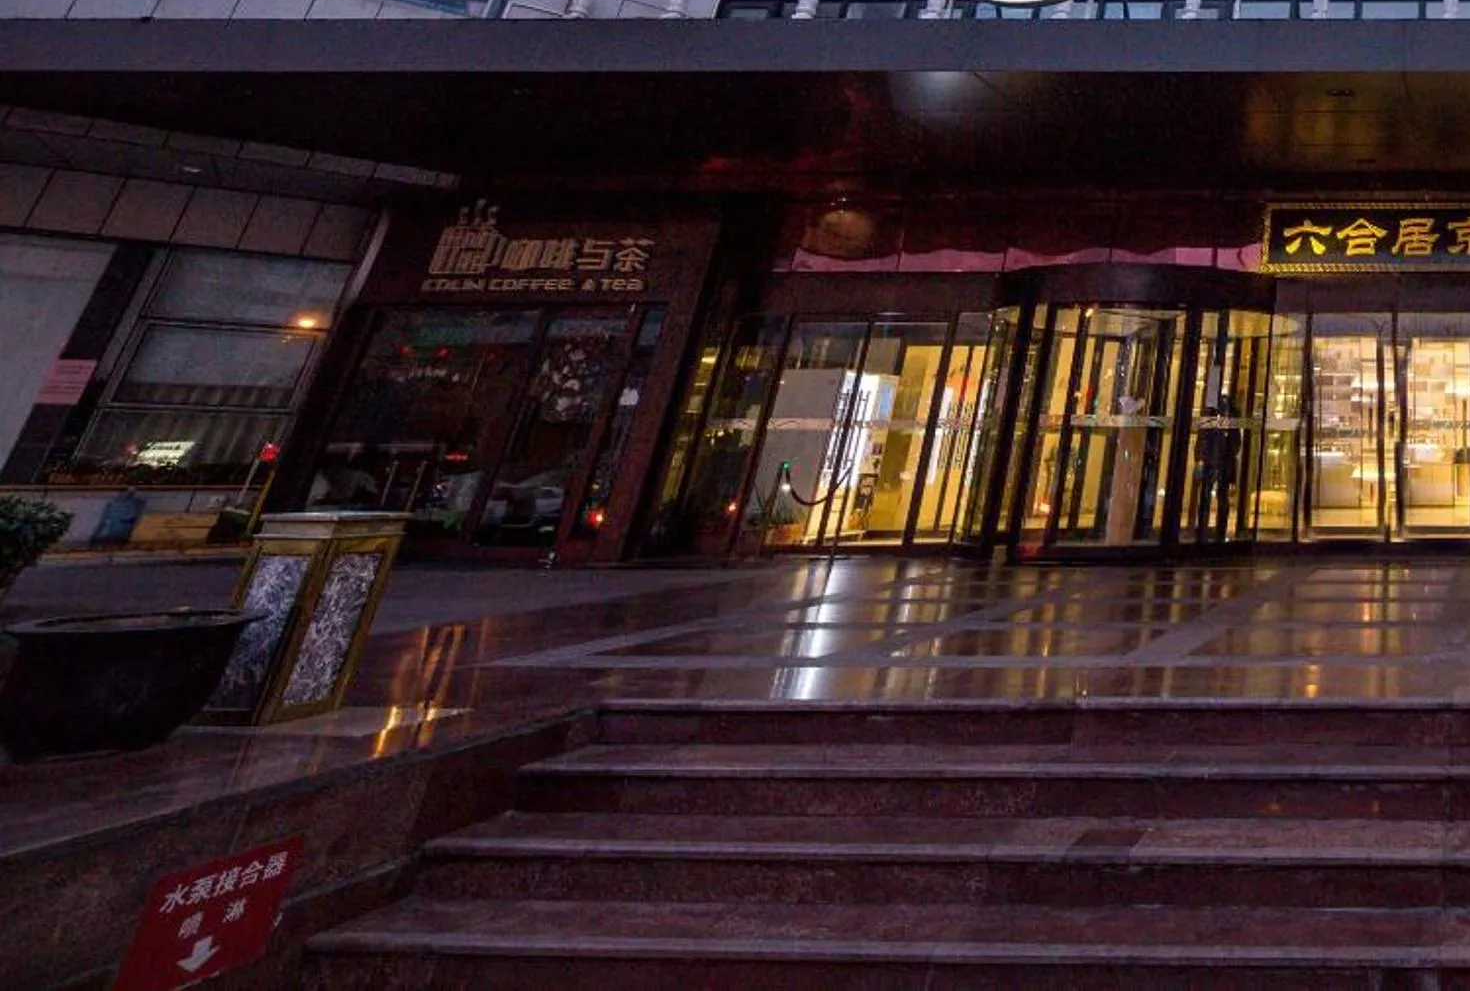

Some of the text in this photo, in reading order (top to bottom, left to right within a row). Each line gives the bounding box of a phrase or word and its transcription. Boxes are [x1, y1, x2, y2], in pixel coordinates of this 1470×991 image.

[159, 852, 288, 913] 水泵接合器
